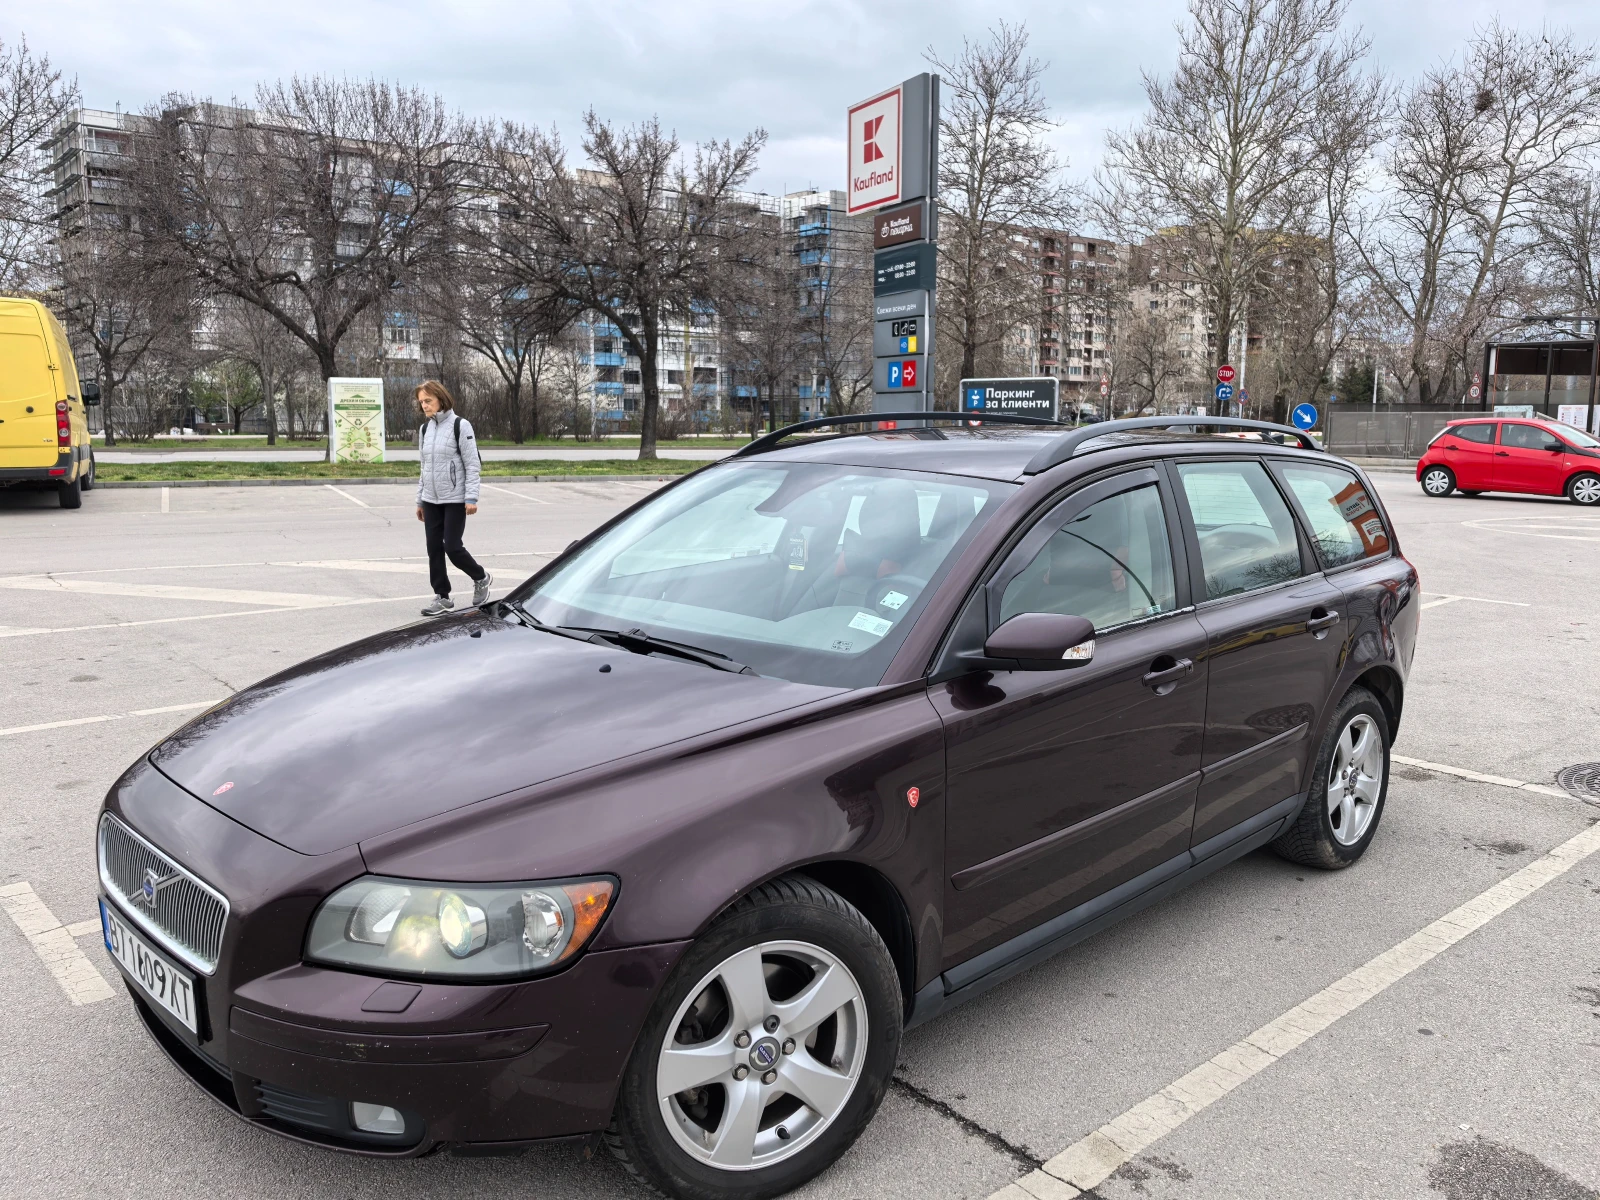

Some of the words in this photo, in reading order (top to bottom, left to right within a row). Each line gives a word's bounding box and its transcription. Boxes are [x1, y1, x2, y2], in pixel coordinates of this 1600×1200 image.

[853, 165, 894, 193] Kaufland
[891, 366, 899, 383] P
[1219, 369, 1234, 378] STOP
[985, 387, 1035, 400] Паркинг
[985, 400, 998, 408] за
[1001, 400, 1050, 408] клиенти
